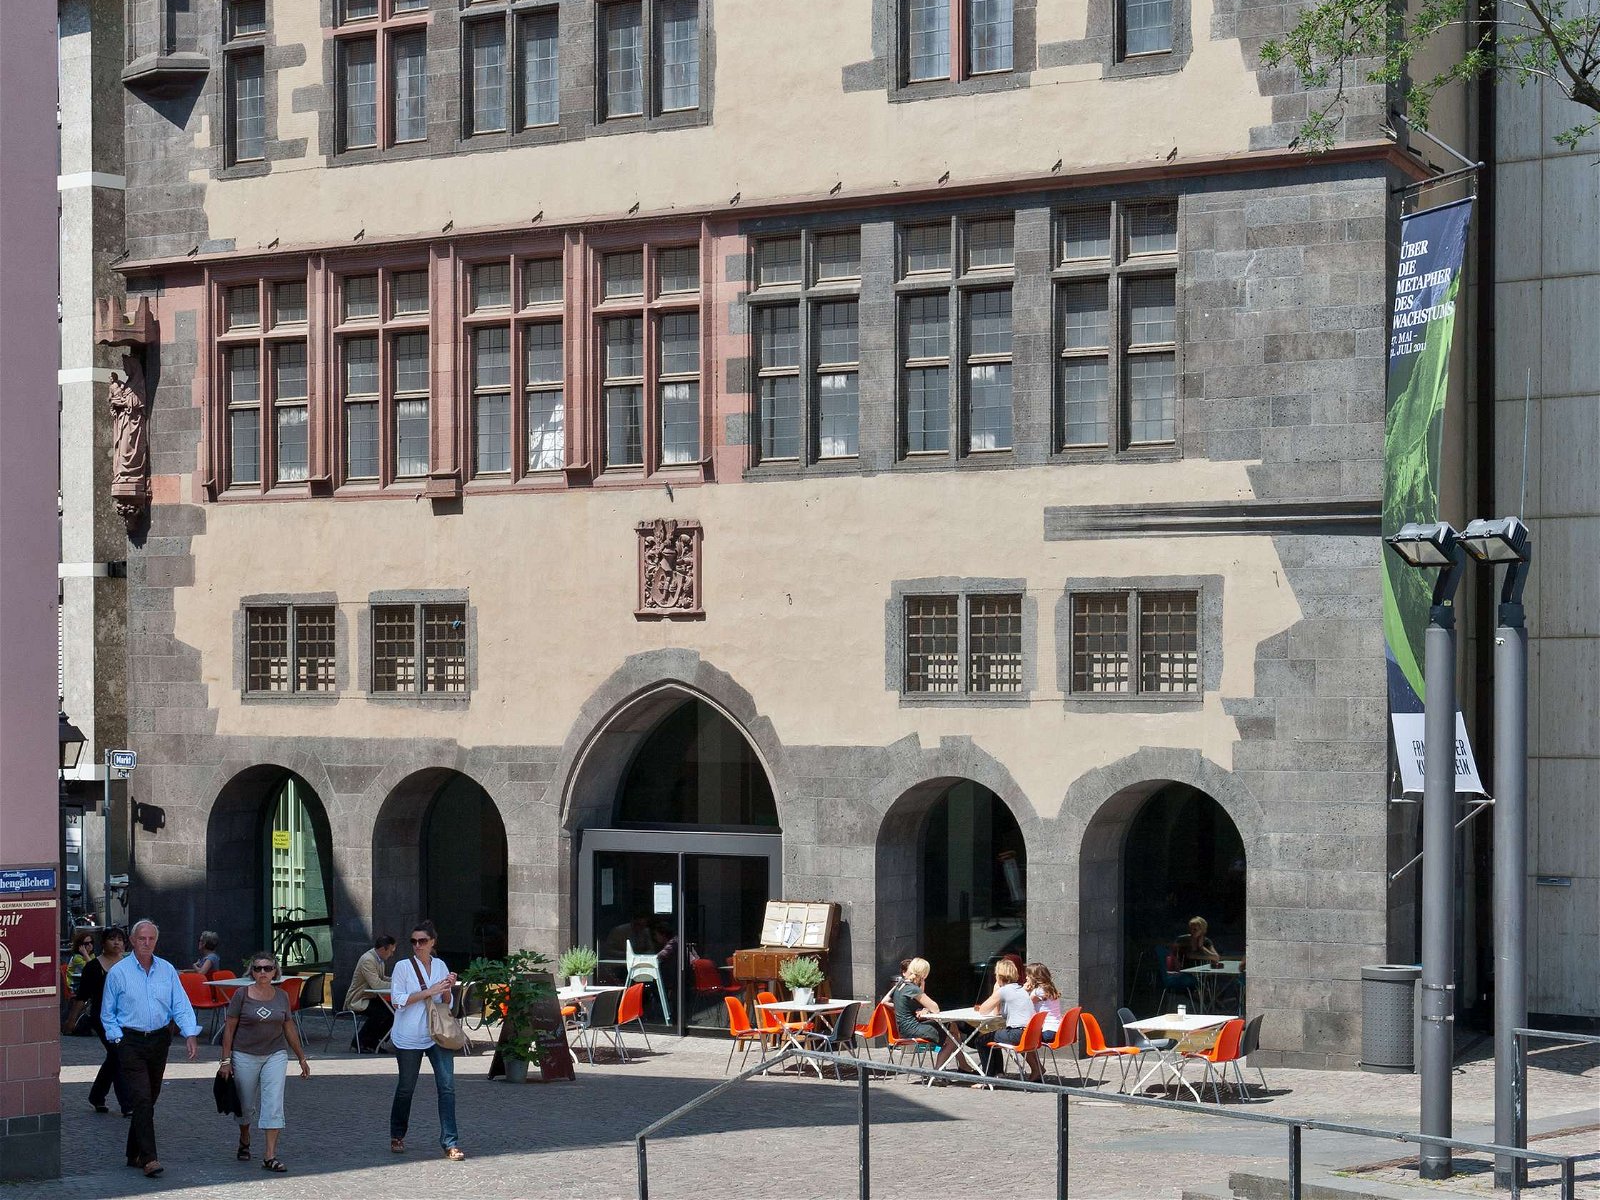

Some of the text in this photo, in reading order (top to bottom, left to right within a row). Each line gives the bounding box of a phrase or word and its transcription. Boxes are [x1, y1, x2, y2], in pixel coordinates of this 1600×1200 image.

[1400, 240, 1428, 260] ÜBER
[1398, 260, 1416, 277] DIE
[1396, 267, 1451, 295] METAPHER
[1394, 295, 1414, 312] DES
[1392, 300, 1455, 330] WACHSTUMS
[1398, 330, 1413, 344] MAI
[1396, 342, 1413, 356] JULI
[116, 755, 132, 765] Markt
